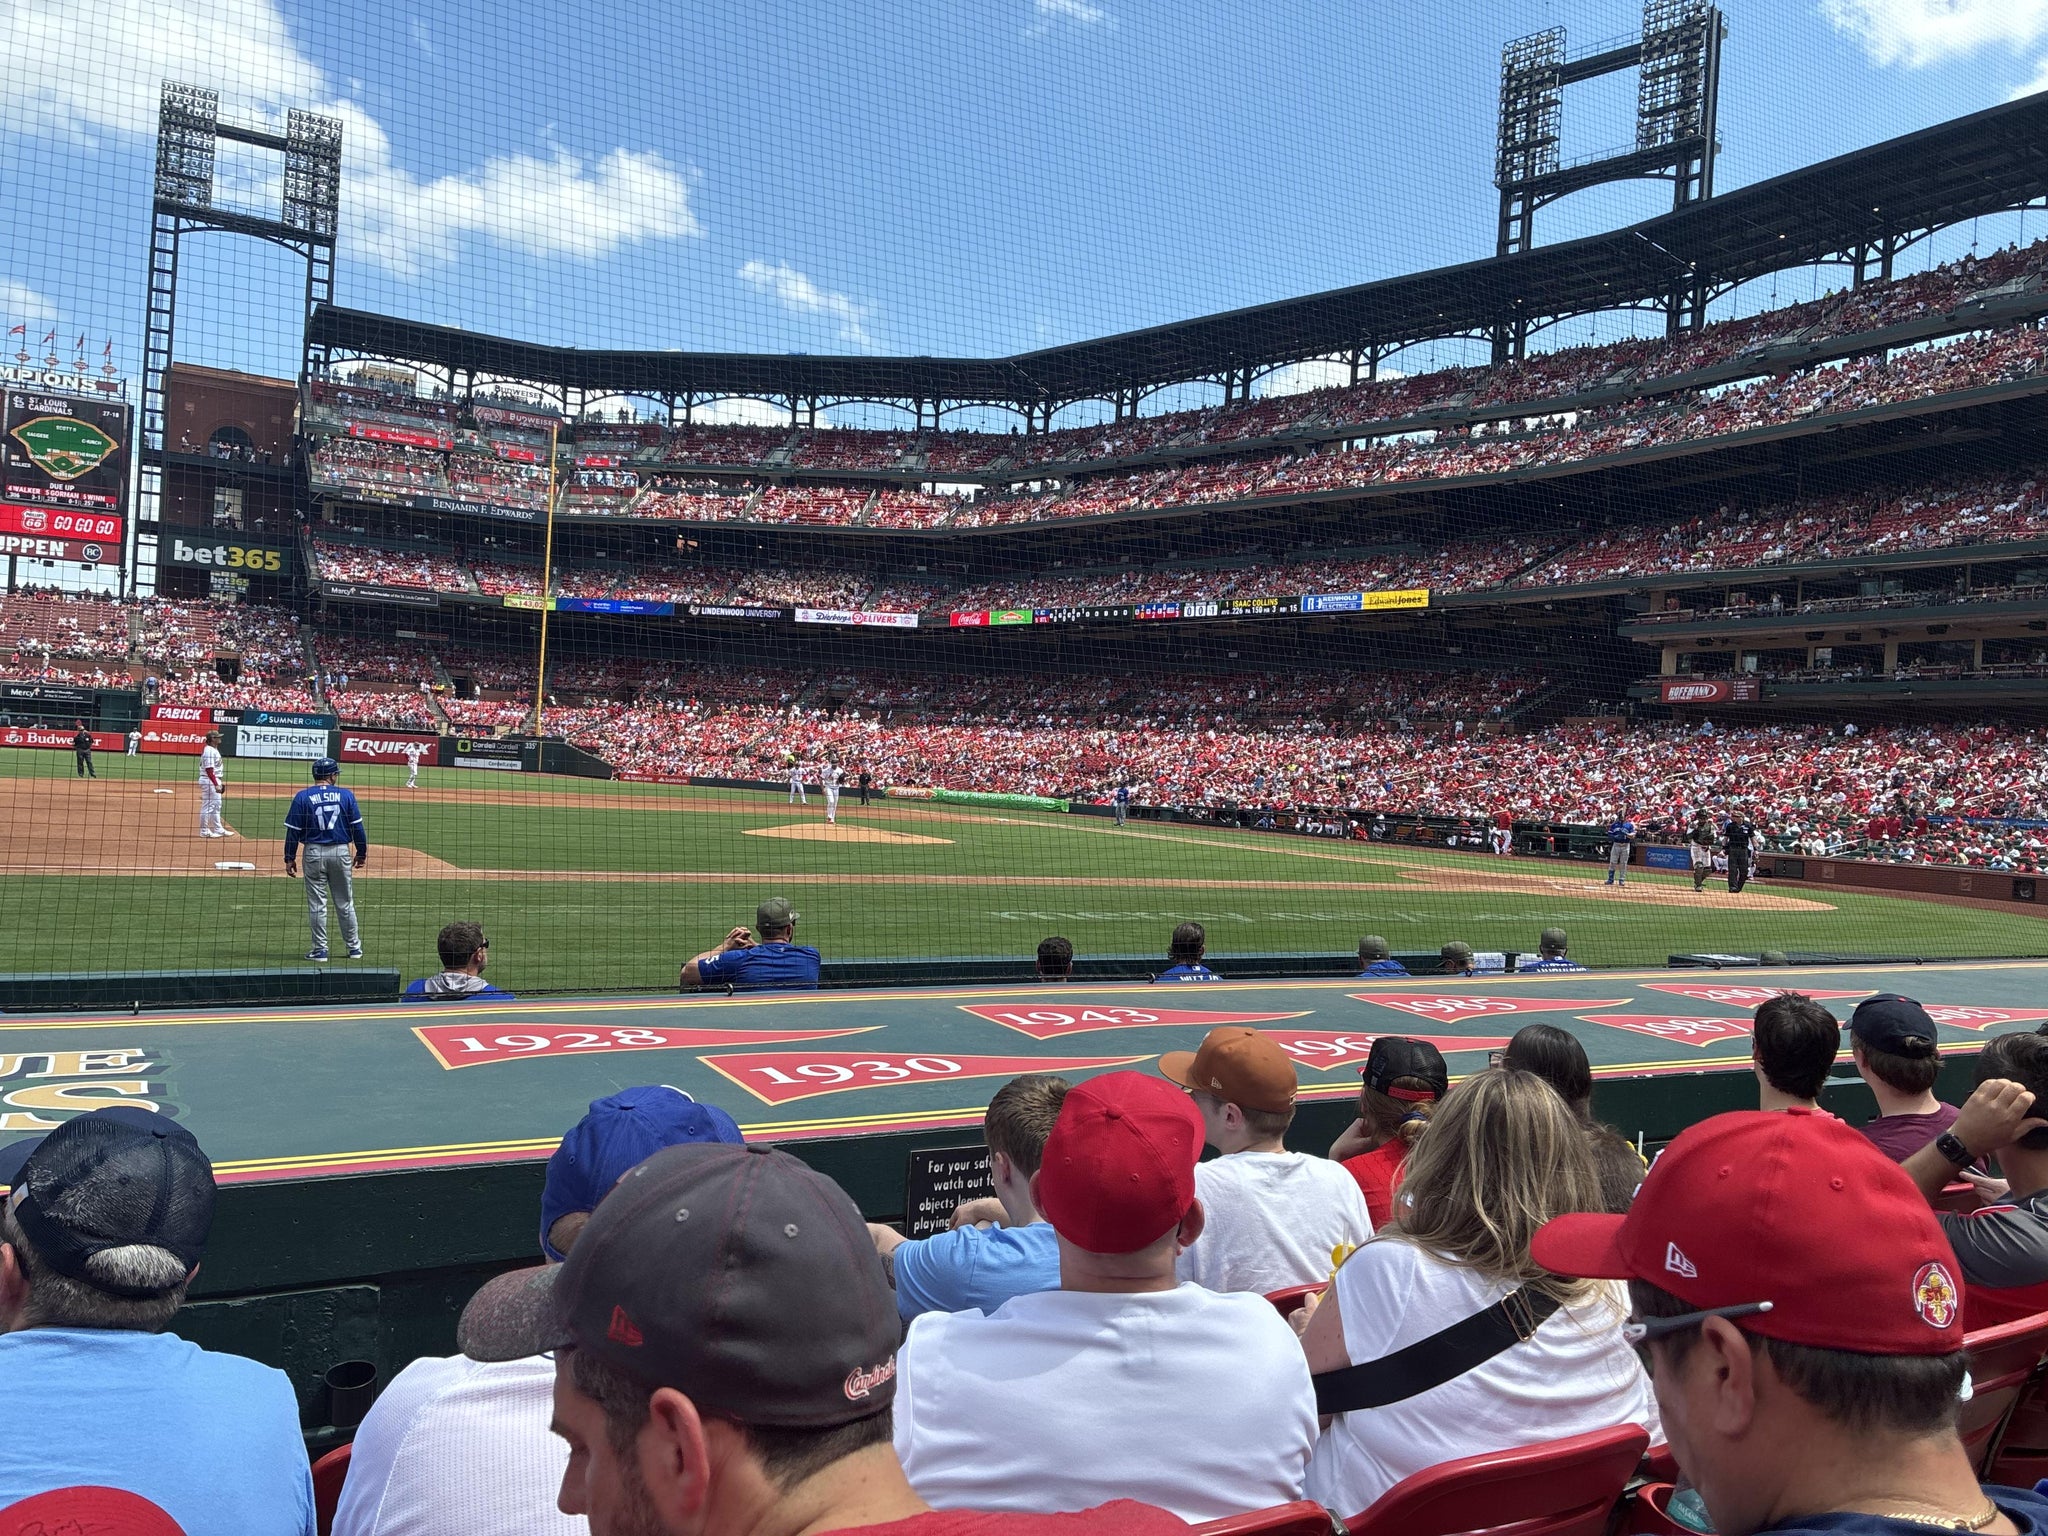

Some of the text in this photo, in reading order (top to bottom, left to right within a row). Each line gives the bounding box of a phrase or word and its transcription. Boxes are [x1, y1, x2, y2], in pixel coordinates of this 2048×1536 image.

[29, 404, 73, 416] CARDINALS
[44, 399, 68, 408] LOUIS
[509, 412, 558, 427] BUDWEISER
[13, 486, 41, 494] WALKER
[50, 490, 79, 499] GORMAN
[87, 494, 106, 502] WINN
[433, 499, 534, 520] BENJAMIN F. EDWARDS
[26, 516, 114, 535] 66 GO GO GO
[86, 547, 99, 557] BC
[174, 539, 281, 571] bet365
[210, 575, 250, 587] bet365
[331, 587, 352, 596] Mercy
[1230, 607, 1243, 615] .226
[1252, 606, 1262, 614] 150
[1290, 604, 1297, 612] 15
[1233, 600, 1251, 608] ISAAC
[1252, 598, 1278, 607] COLLINS
[701, 607, 745, 617] LINDENWOOD
[745, 608, 782, 619] UNIVERSITY
[852, 612, 897, 624] DELIVERS
[10, 688, 35, 698] Mercy
[1668, 686, 1710, 697] HOFFMANN
[156, 707, 203, 721] FABICK
[213, 715, 239, 724] RENTALS
[27, 732, 102, 746] Budwer
[254, 733, 326, 745] PERFICIENT
[472, 741, 519, 750] Cordell Cordell
[343, 737, 431, 757] EQUIFAX
[309, 792, 341, 805] WILSON
[895, 788, 926, 797] SERVPRO
[315, 804, 341, 831] 17
[1683, 987, 1785, 1000] 2004
[1384, 998, 1518, 1013] 1985
[994, 1008, 1159, 1027] 1943
[1621, 1019, 1751, 1036] 1987
[448, 1028, 668, 1053] 1928
[749, 1057, 963, 1085] 1930
[928, 1160, 945, 1174] For
[948, 1160, 971, 1175] your
[933, 1176, 964, 1192] watch
[967, 1177, 983, 1189] out
[919, 1197, 954, 1214] objects
[914, 1216, 950, 1235] playing
[844, 1354, 896, 1400] Cardinals
